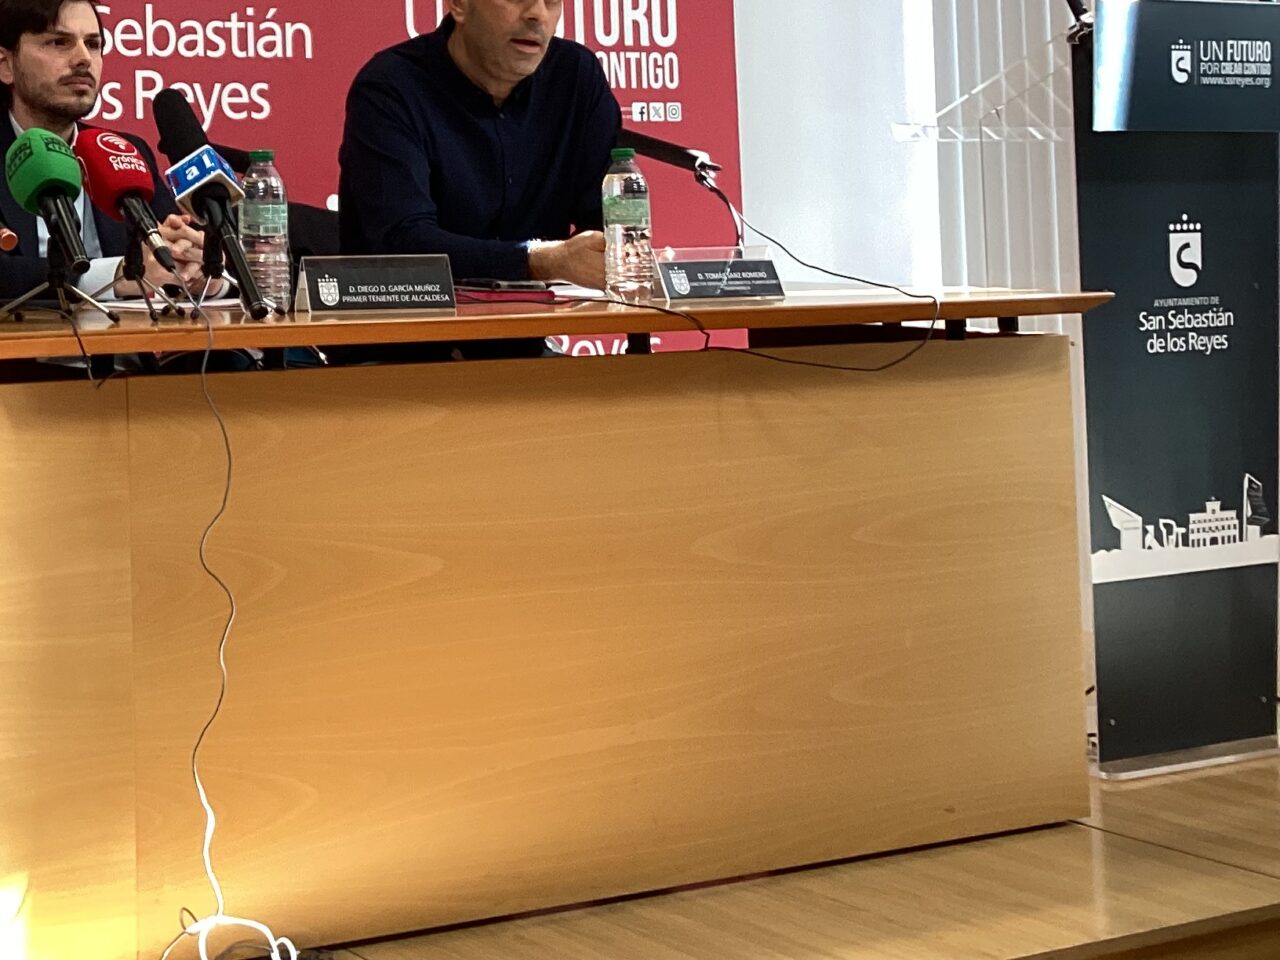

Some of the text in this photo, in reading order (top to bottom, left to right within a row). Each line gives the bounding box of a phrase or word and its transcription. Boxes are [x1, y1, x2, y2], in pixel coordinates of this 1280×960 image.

[1200, 40, 1271, 62] UN FUTURO
[1200, 62, 1220, 74] POR
[348, 285, 356, 293] D.
[388, 283, 413, 292] GARCÍA
[414, 283, 440, 292] MUÑOZ
[342, 294, 450, 303] PRIMER TENIENTE DE ALCALDESA
[1153, 295, 1220, 307] AYUNTAMIENTO DE
[1139, 307, 1234, 331] San Sebastián
[1147, 332, 1228, 355] de los Reyes
